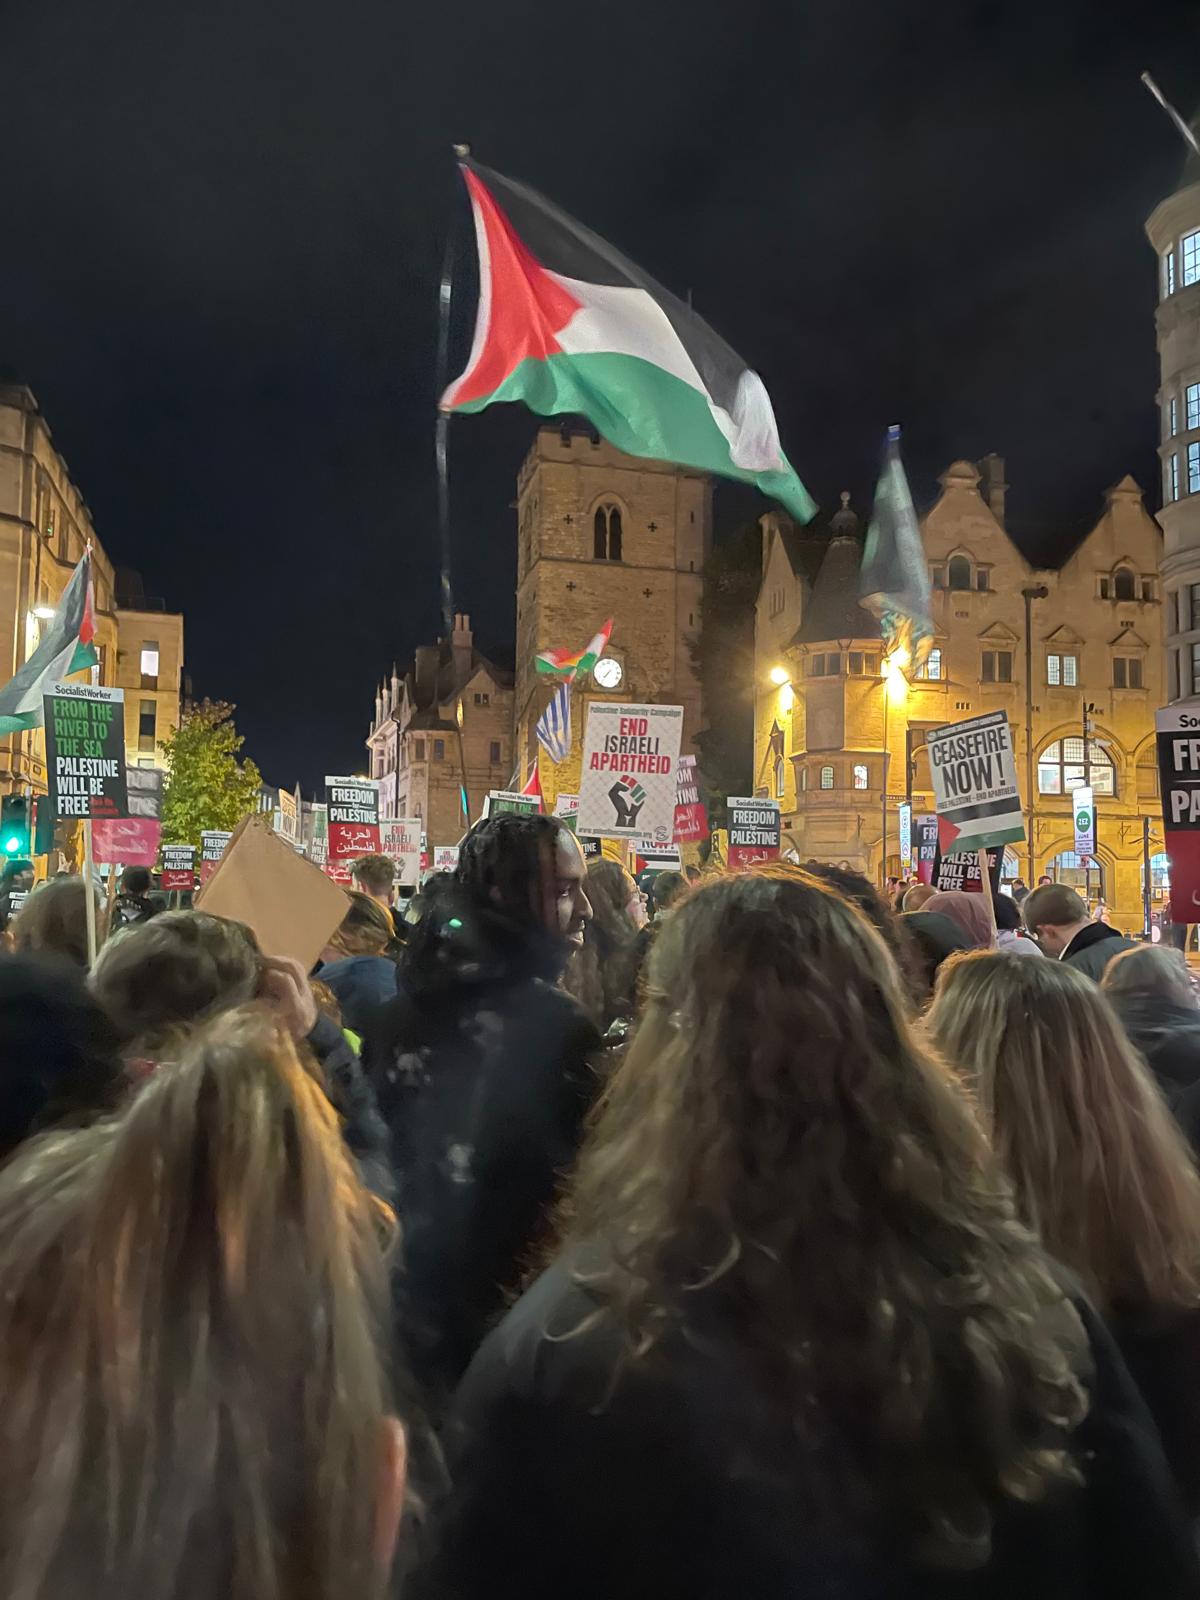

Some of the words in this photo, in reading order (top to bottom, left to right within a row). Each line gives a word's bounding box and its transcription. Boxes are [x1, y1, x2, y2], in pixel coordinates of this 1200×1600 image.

[53, 699, 88, 719] FROM
[90, 703, 113, 721] THE
[54, 718, 89, 738] RIVER
[92, 722, 108, 740] TO
[620, 718, 648, 736] END
[1179, 714, 1200, 728] So
[55, 738, 80, 756] THE
[83, 740, 103, 758] SEA
[604, 735, 659, 755] ISRAELI
[932, 726, 1008, 767] CEASEFIRE
[56, 757, 119, 777] PALESTINE
[589, 752, 671, 774] APARTHEID
[57, 777, 88, 795] WILL
[89, 778, 104, 796] BE
[331, 788, 375, 804] FREEDOM
[57, 796, 89, 815] FREE
[330, 808, 377, 824] PALESTINE
[733, 810, 775, 825] FREEDOM
[731, 830, 777, 845] PALESTINE
[164, 862, 193, 870] PALESTINE
[939, 864, 964, 877] WILL
[966, 866, 980, 879] BE
[937, 877, 963, 890] FREE
